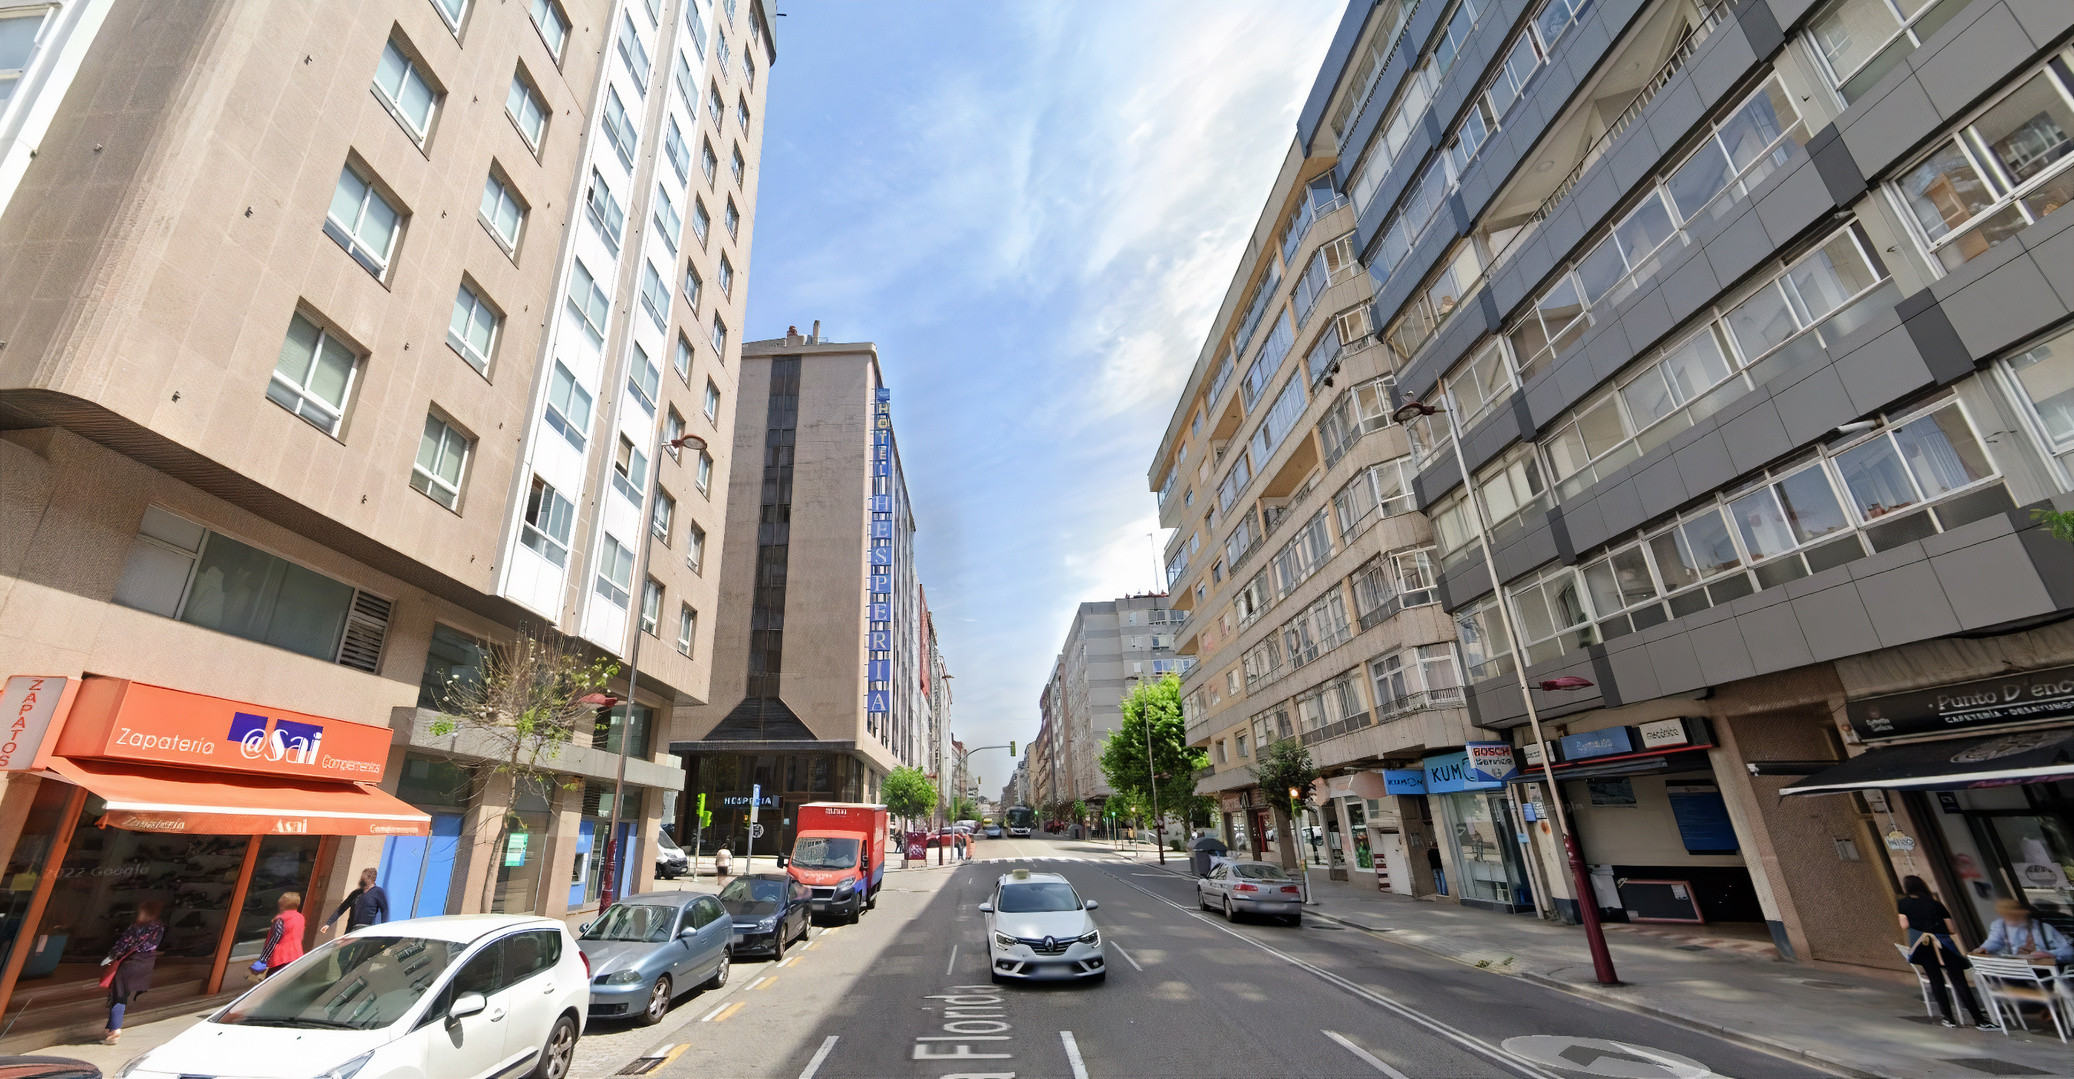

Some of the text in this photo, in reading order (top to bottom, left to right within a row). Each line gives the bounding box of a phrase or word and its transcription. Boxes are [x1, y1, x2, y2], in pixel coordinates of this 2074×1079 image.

[871, 496, 890, 712] HESPERIA
[1937, 690, 1998, 710] Punto
[0, 679, 44, 767] ZAPATOS
[116, 727, 215, 755] Zapatería
[1473, 747, 1511, 757] BOSCH
[1431, 757, 1475, 782] KUMO
[724, 797, 772, 805] HESPIA
